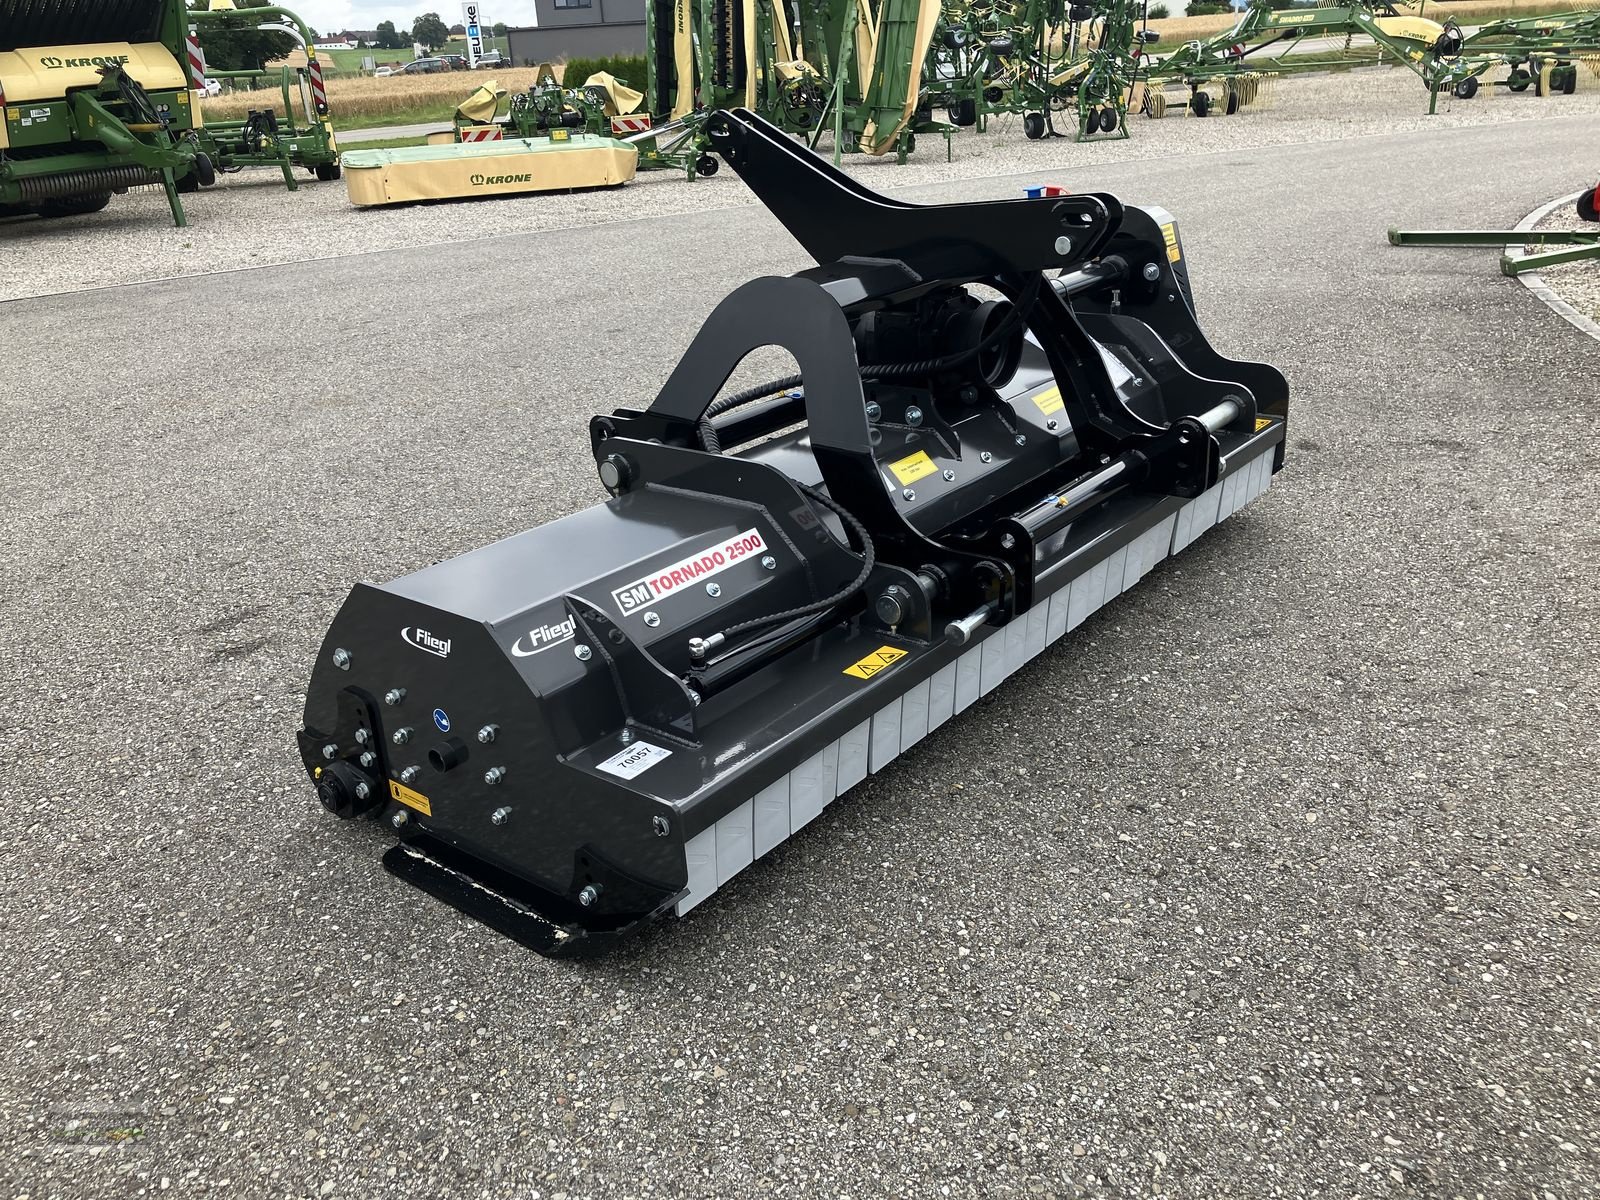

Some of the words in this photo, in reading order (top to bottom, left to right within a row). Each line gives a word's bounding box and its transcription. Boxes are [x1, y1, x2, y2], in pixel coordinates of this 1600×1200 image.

[486, 173, 532, 185] KRONE
[619, 583, 651, 609] SM
[649, 551, 727, 595] TORNADO
[725, 534, 762, 561] 2500
[416, 628, 452, 656] Fliegl
[529, 614, 577, 647] Fliegl
[617, 747, 651, 768] 70057
